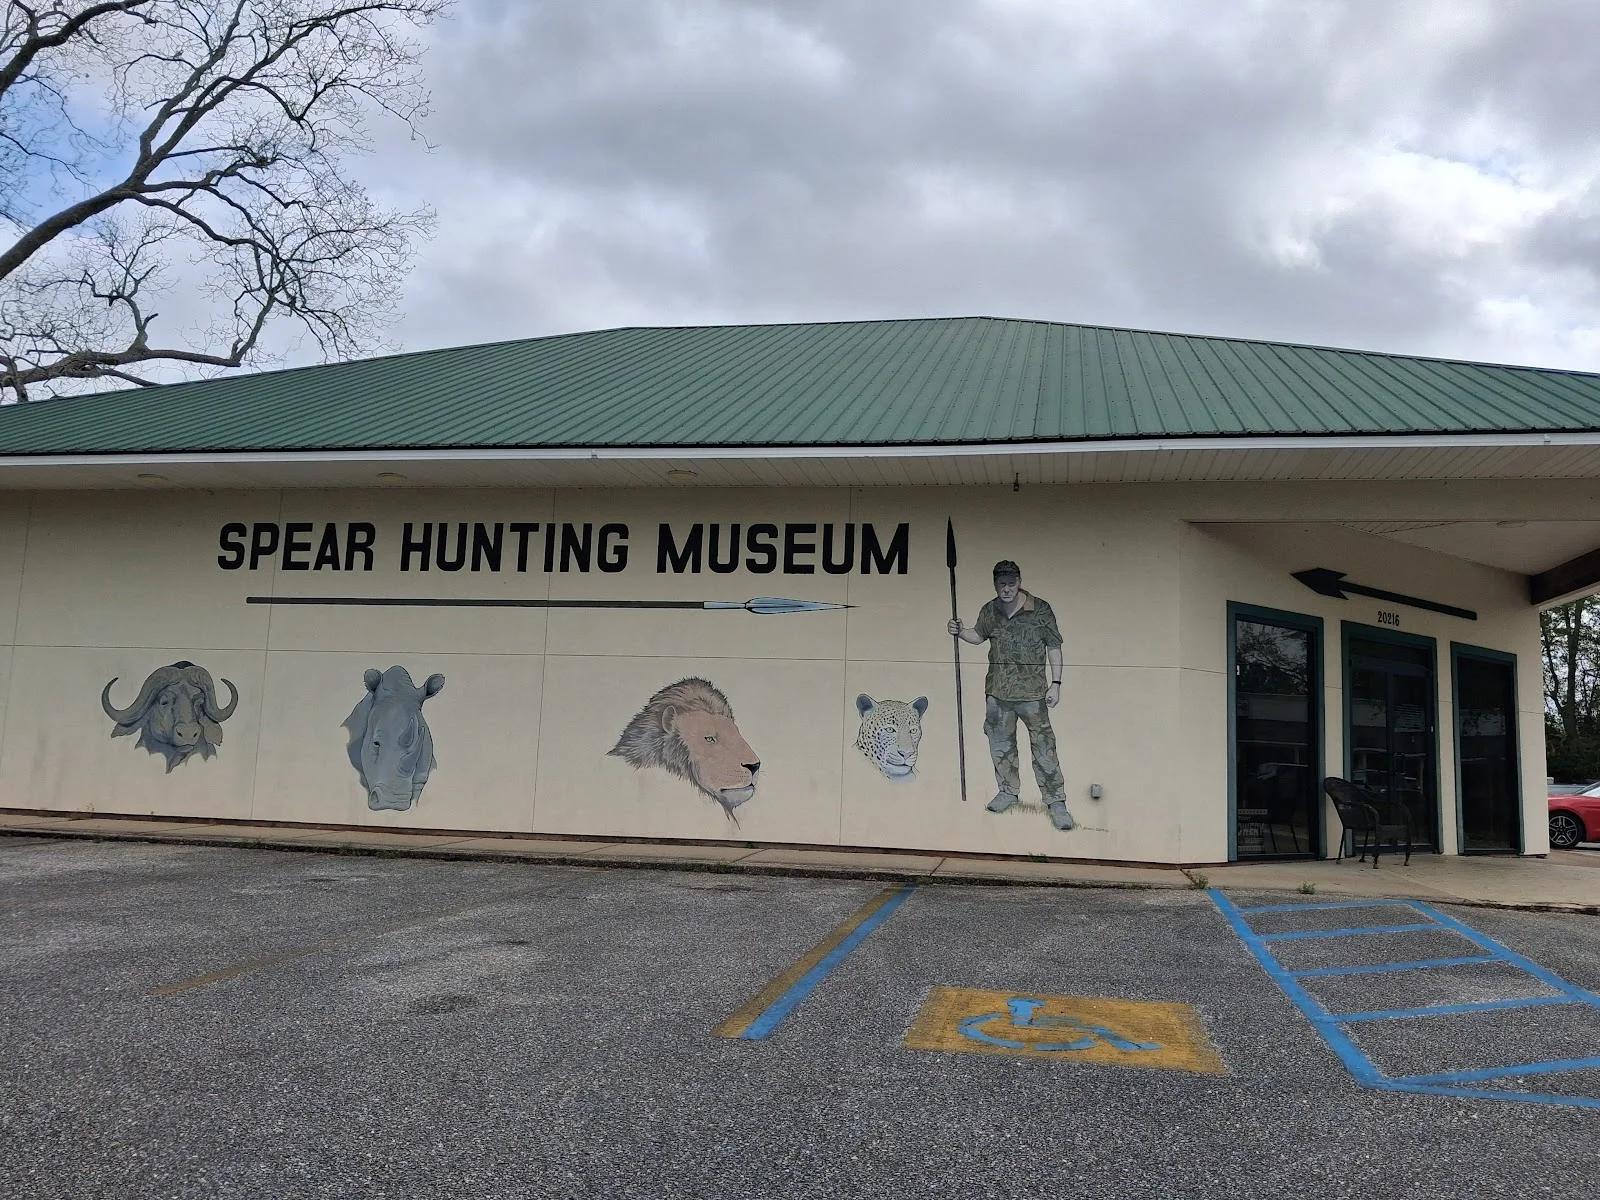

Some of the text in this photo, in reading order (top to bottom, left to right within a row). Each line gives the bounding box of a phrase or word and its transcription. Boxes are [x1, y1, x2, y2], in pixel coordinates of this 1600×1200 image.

[218, 522, 909, 575] SPEAR HUNTING MUSEUM
[1377, 610, 1400, 626] 20216
